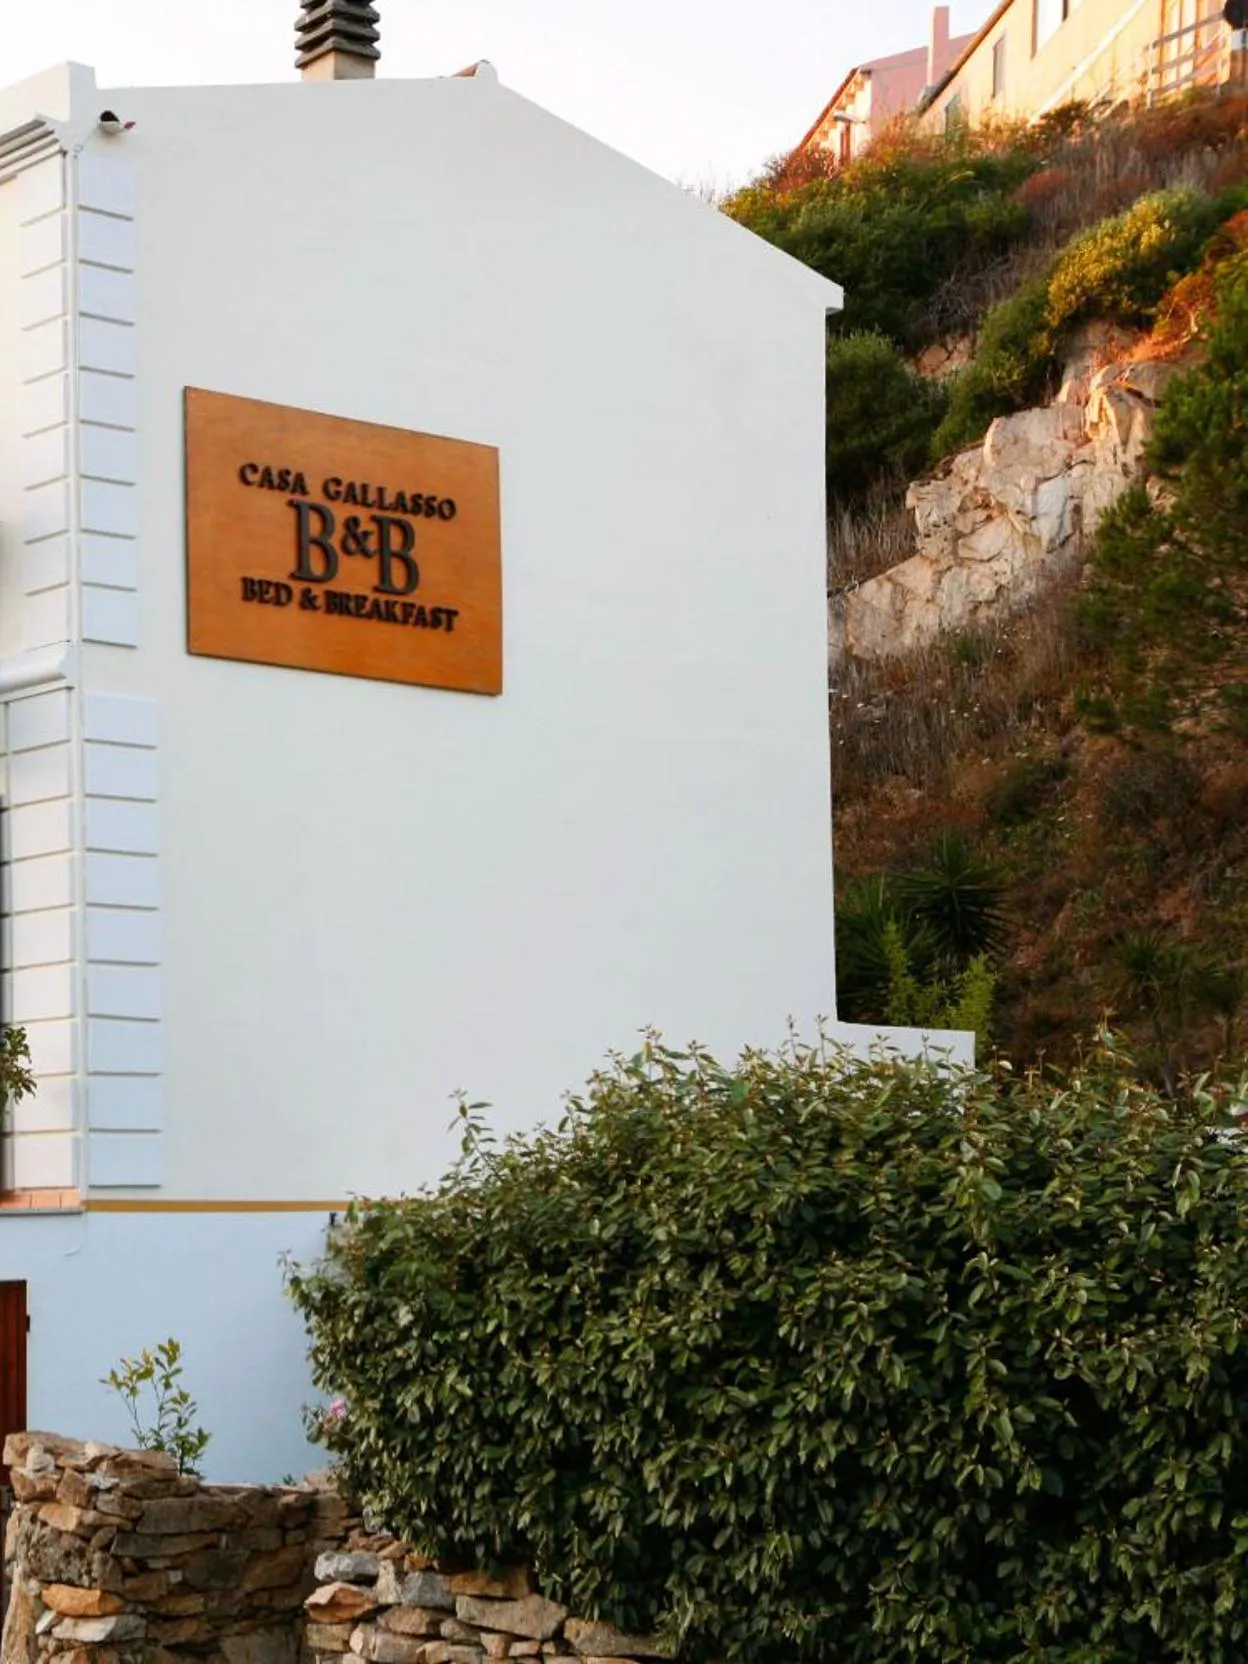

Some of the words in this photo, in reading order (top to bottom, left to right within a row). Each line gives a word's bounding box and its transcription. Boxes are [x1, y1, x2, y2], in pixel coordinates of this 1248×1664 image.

[239, 463, 309, 496] CASA
[322, 477, 456, 521] GALLASSO
[286, 499, 420, 595] B&B
[241, 577, 292, 606] BED
[299, 588, 322, 611] &
[324, 589, 459, 632] BREAKFAST
